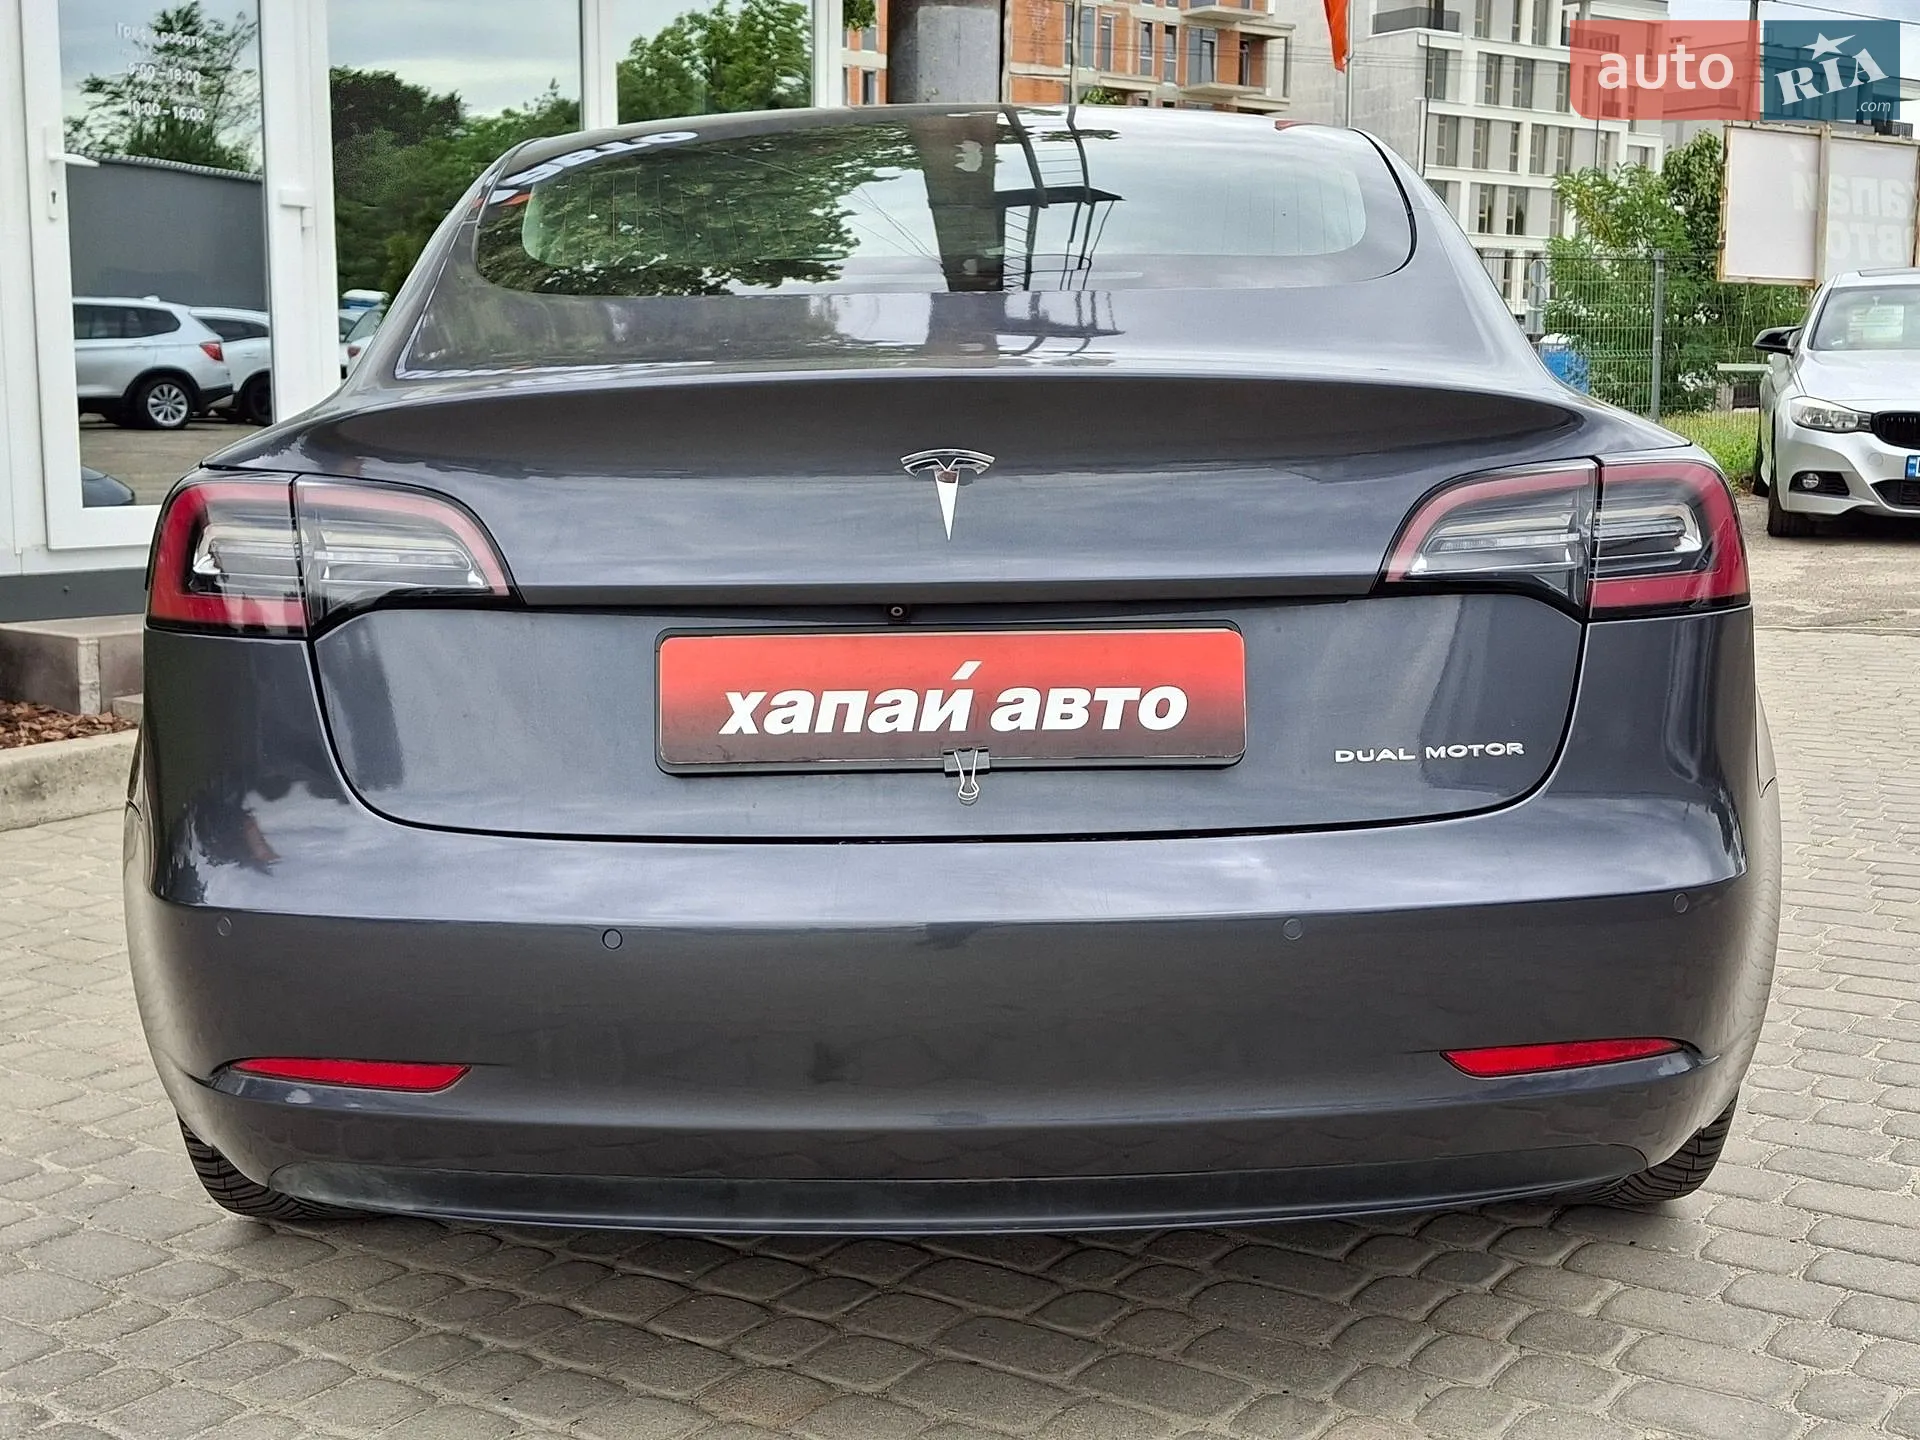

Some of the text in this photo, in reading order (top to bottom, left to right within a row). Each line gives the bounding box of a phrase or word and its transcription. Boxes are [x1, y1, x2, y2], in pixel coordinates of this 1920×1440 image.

[172, 105, 206, 121] 16:00
[718, 661, 1188, 735] хапай авто
[1334, 742, 1525, 763] DUAL MOTOR
